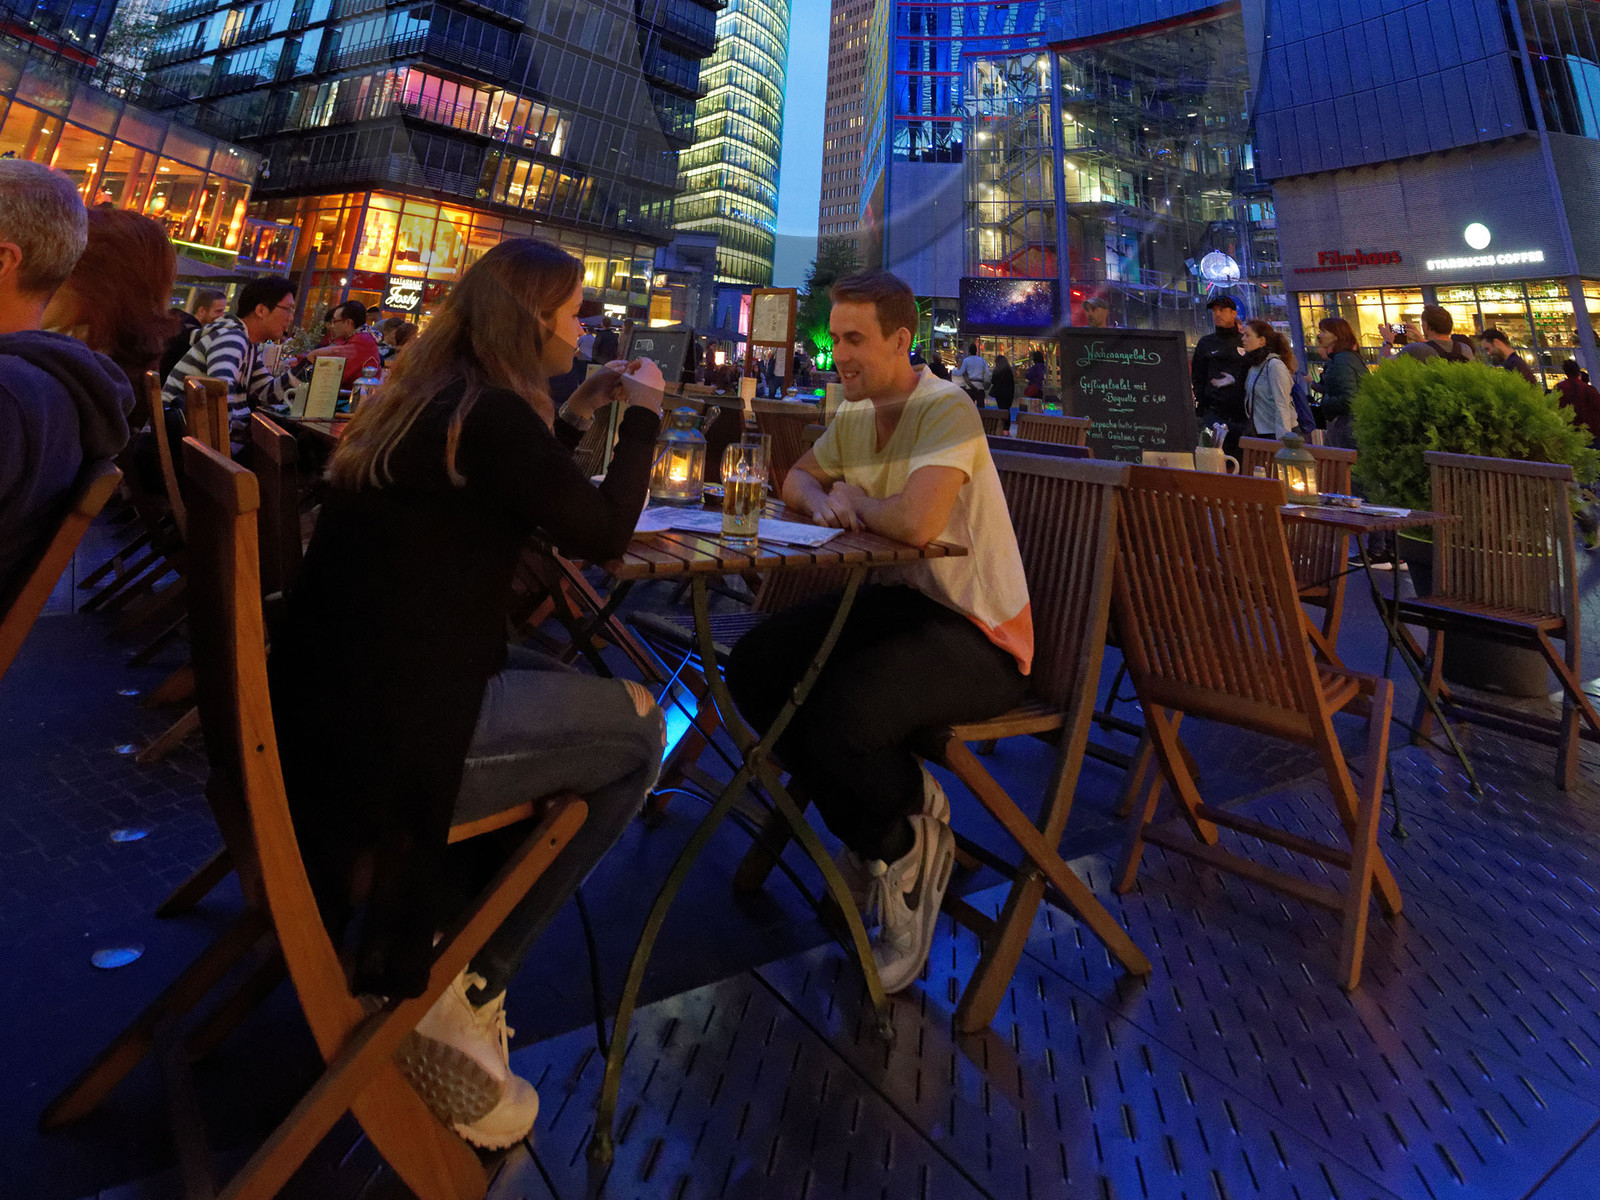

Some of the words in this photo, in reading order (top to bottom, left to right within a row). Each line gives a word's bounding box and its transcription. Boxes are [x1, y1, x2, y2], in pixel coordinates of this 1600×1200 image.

[1318, 249, 1401, 265] Filmhaus
[1426, 255, 1496, 270] STARBUCKS
[1496, 250, 1545, 265] COFFEE
[385, 286, 420, 310] Josty
[1080, 341, 1148, 366] Wochenangebot
[1133, 382, 1147, 391] mit
[1142, 395, 1150, 403] €
